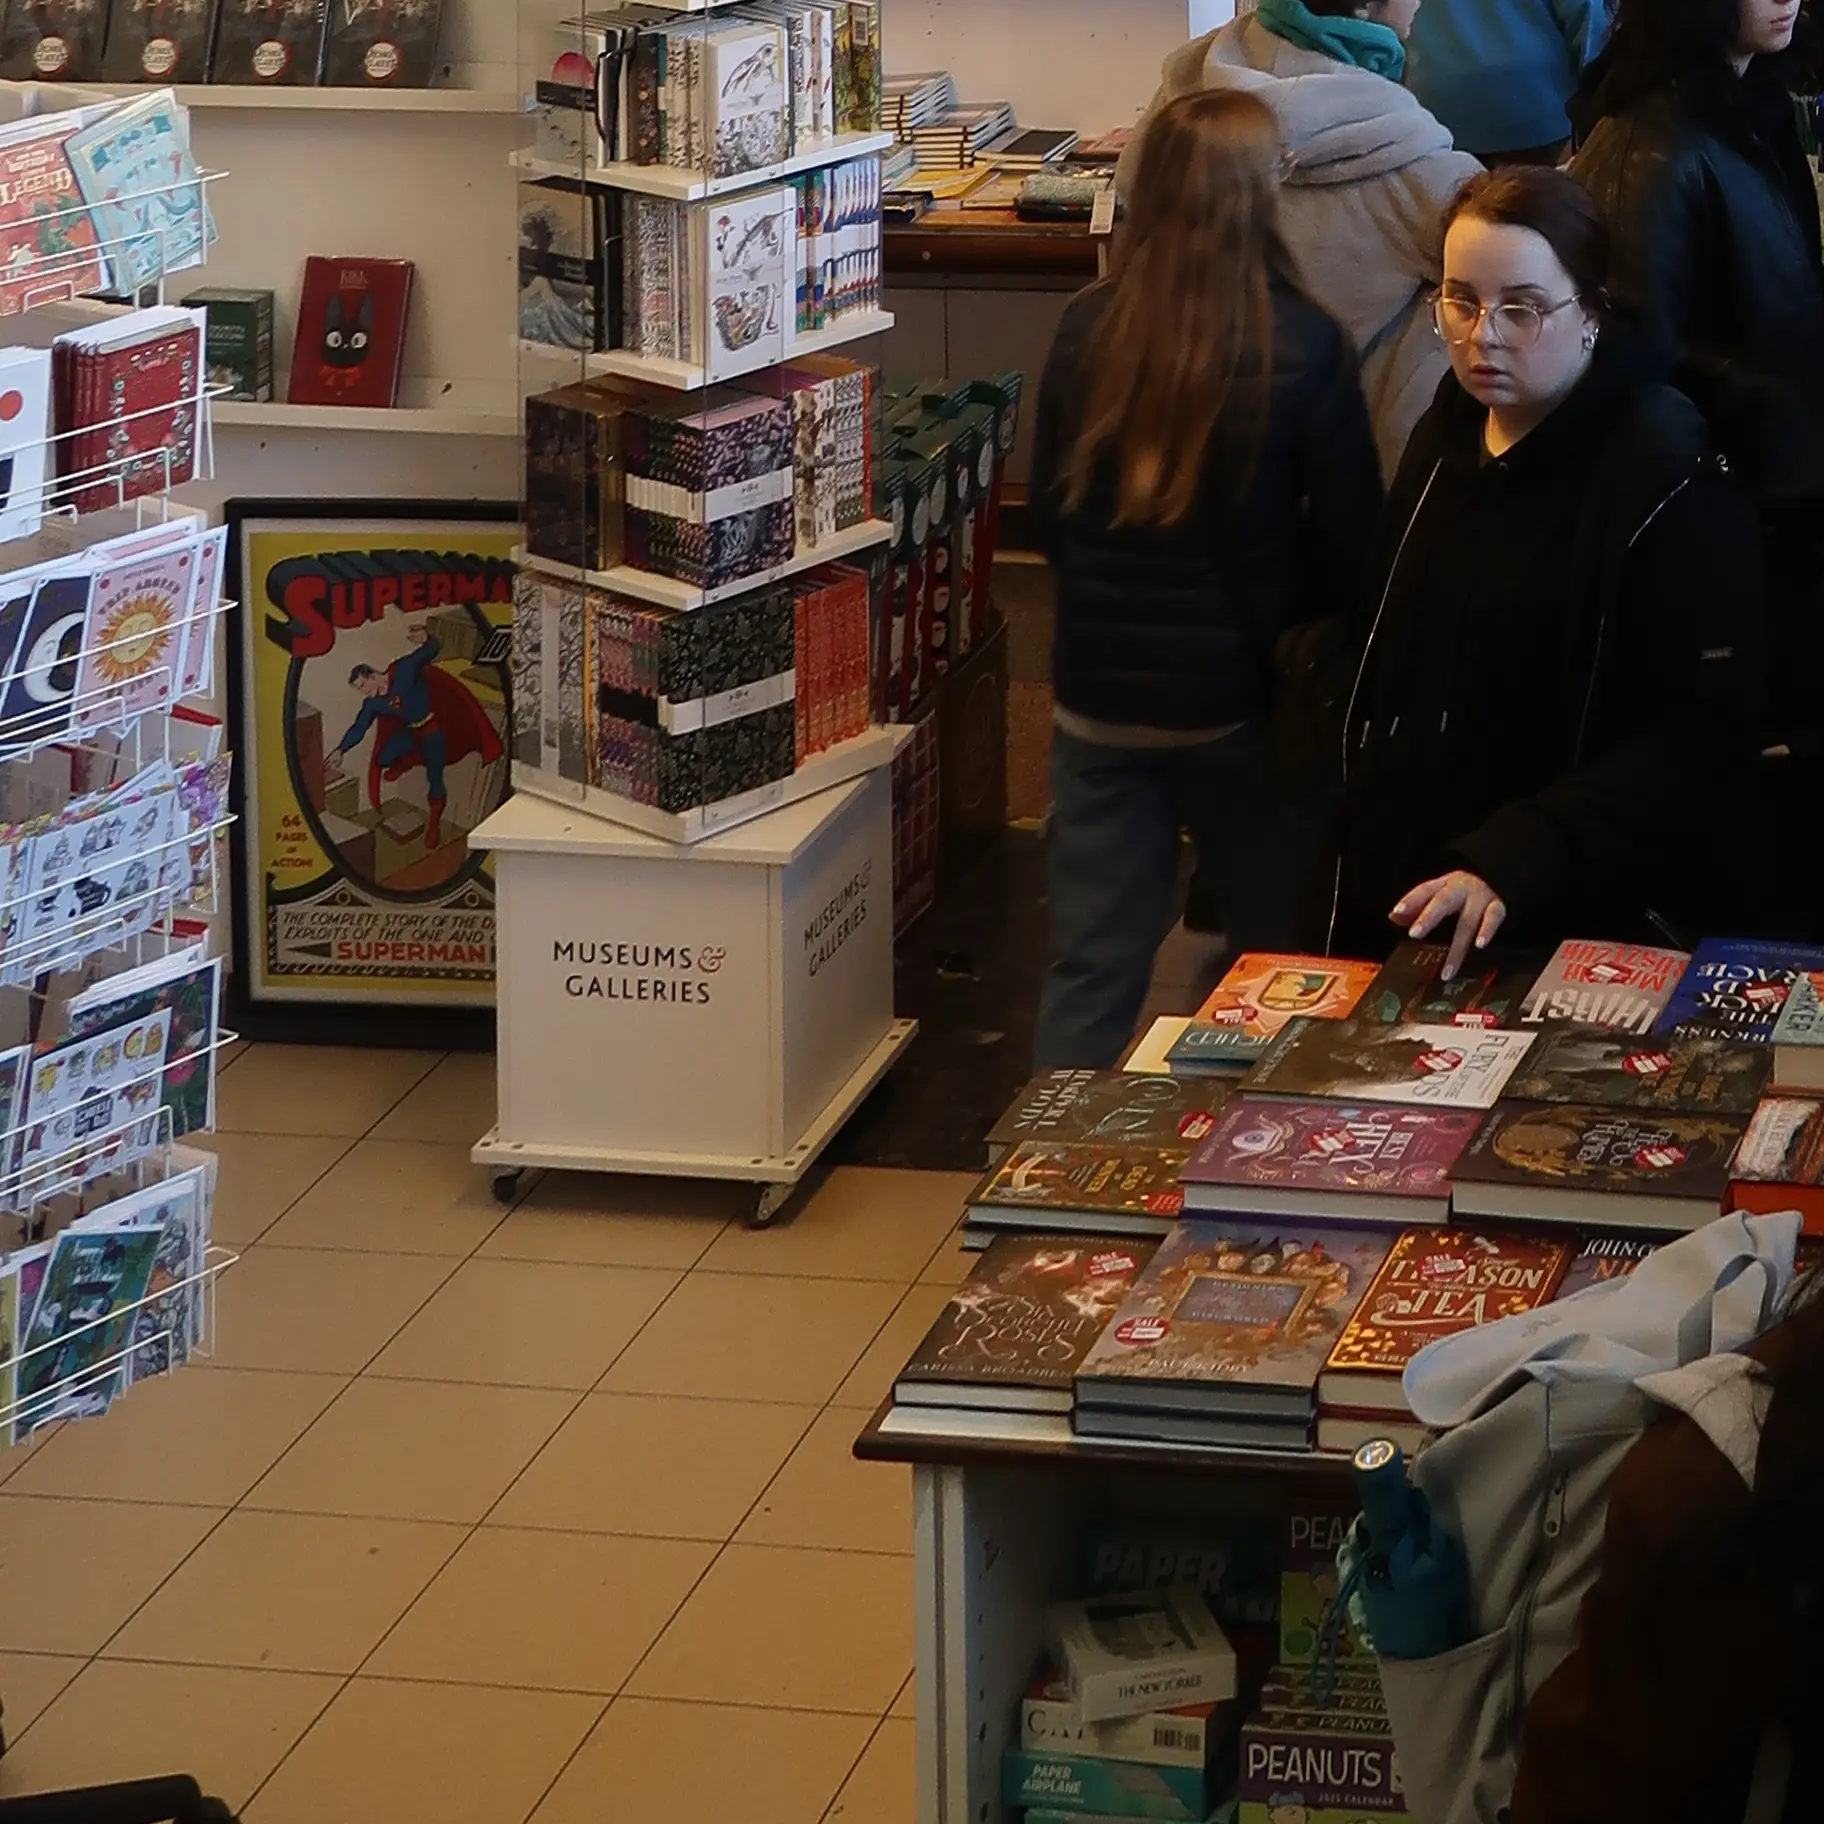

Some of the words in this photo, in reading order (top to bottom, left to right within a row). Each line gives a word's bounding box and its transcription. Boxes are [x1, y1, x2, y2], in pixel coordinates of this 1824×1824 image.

[0, 167, 73, 205] LEGEND
[283, 573, 513, 658] SUPERMA
[281, 814, 302, 828] 64
[275, 832, 308, 843] PAGES
[271, 857, 314, 869] ACTION!
[283, 911, 306, 926] THE
[310, 911, 379, 927] COMPLETE
[385, 913, 430, 928] STORY
[432, 914, 449, 928] OF
[452, 915, 481, 930] THE
[803, 872, 862, 952] MUSEUMS
[284, 926, 349, 941] EXPLOITS
[352, 927, 372, 941] OF
[377, 927, 406, 941] THE
[411, 929, 442, 942] ONE
[447, 928, 484, 943] AND
[807, 898, 867, 978] GALLERIES
[336, 941, 487, 964] SUPERMAN
[553, 940, 693, 970] MUSEUMS
[697, 946, 727, 973] &
[564, 974, 711, 1004] GALLERIES
[1520, 987, 1658, 1036] THIRST
[1674, 1023, 1767, 1043] RKNESS
[1468, 1033, 1510, 1075] FURY
[1577, 1238, 1637, 1259] JOHN
[1411, 1288, 1488, 1326] TEA
[907, 1362, 979, 1377] CARISSA
[981, 1363, 1074, 1380] BROADBEN
[1093, 1544, 1229, 1594] PAPER
[1136, 1680, 1162, 1696] NEW
[1319, 1716, 1391, 1731] PEANUT
[1031, 1764, 1072, 1779] PAPER
[1247, 1743, 1383, 1787] PEANUTS
[1022, 1778, 1082, 1795] AIRPLANE
[1343, 1794, 1394, 1807] CALENDAR
